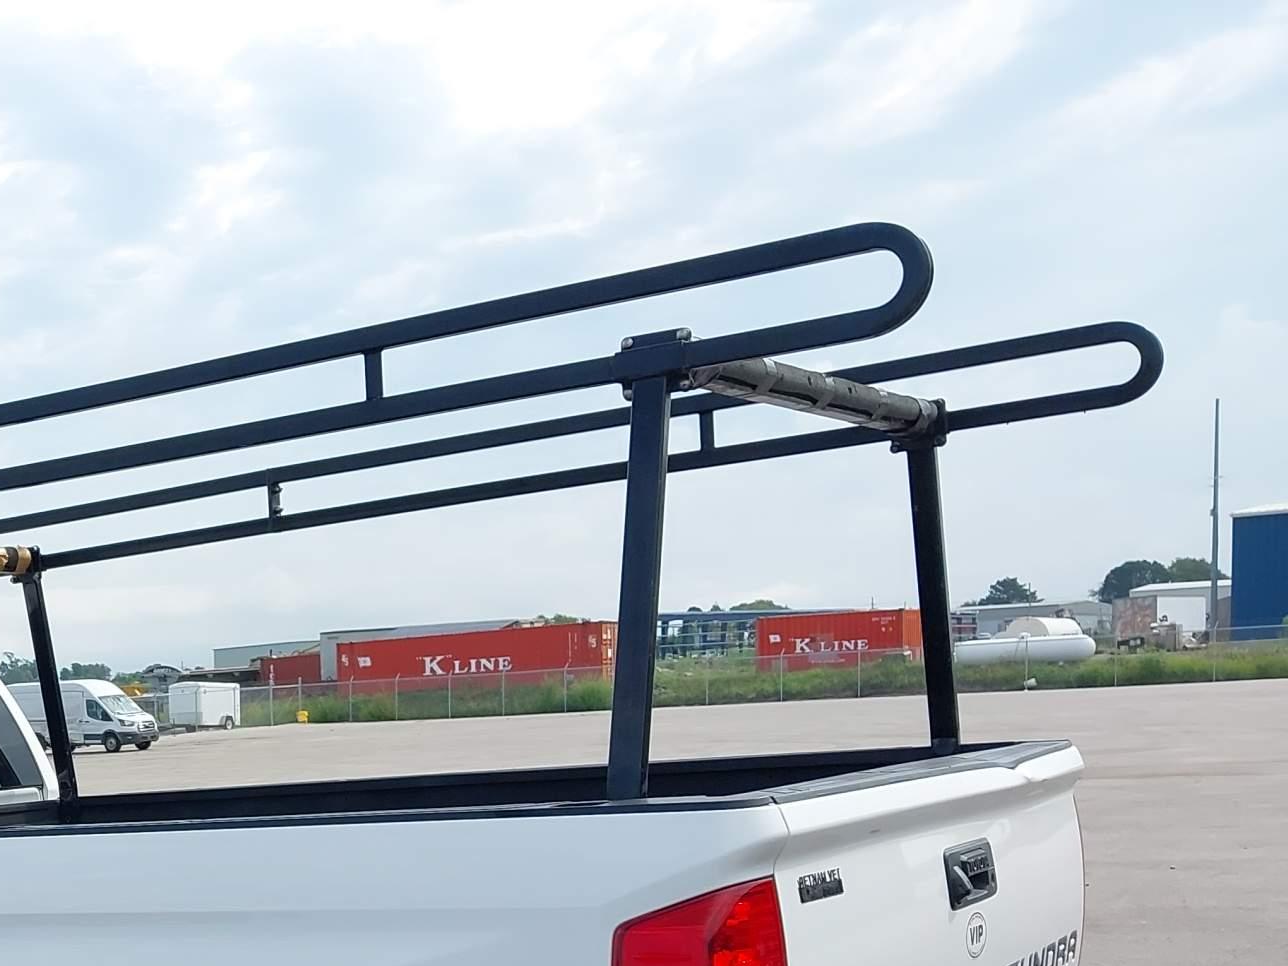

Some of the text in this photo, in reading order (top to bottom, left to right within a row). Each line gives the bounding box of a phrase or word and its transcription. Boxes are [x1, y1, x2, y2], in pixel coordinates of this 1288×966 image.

[820, 639, 869, 652] LINE
[453, 656, 512, 673] LINE
[969, 924, 984, 946] VIP
